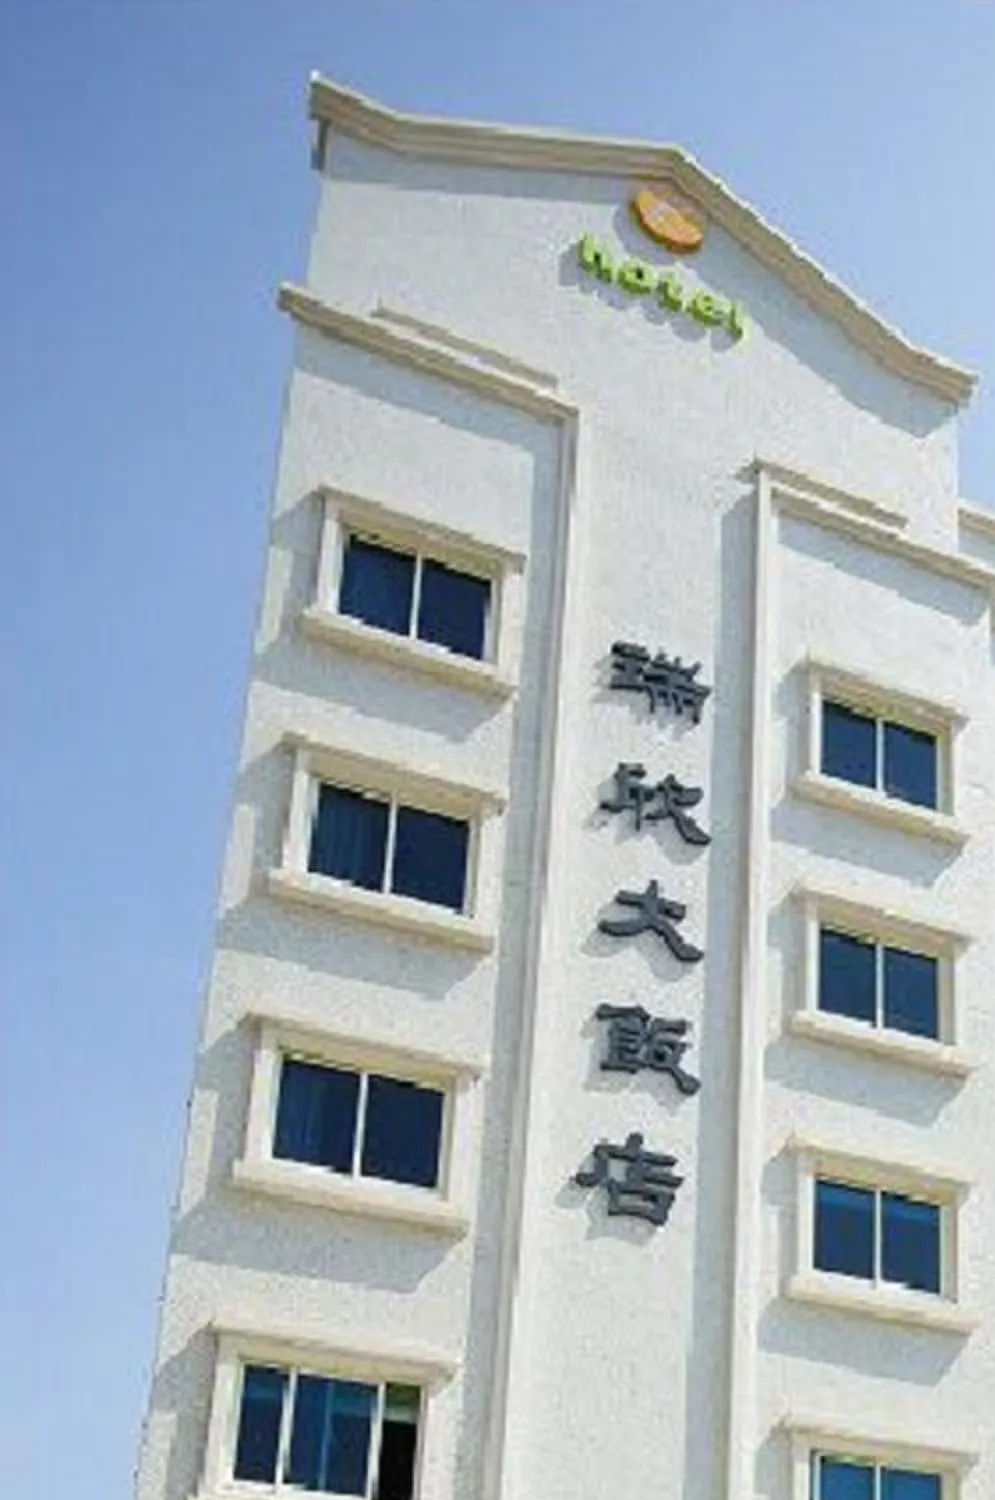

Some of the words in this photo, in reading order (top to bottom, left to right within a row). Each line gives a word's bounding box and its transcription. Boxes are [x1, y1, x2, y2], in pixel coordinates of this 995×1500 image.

[577, 231, 746, 342] hotel
[576, 640, 712, 1227] 瑞欣大飯店
